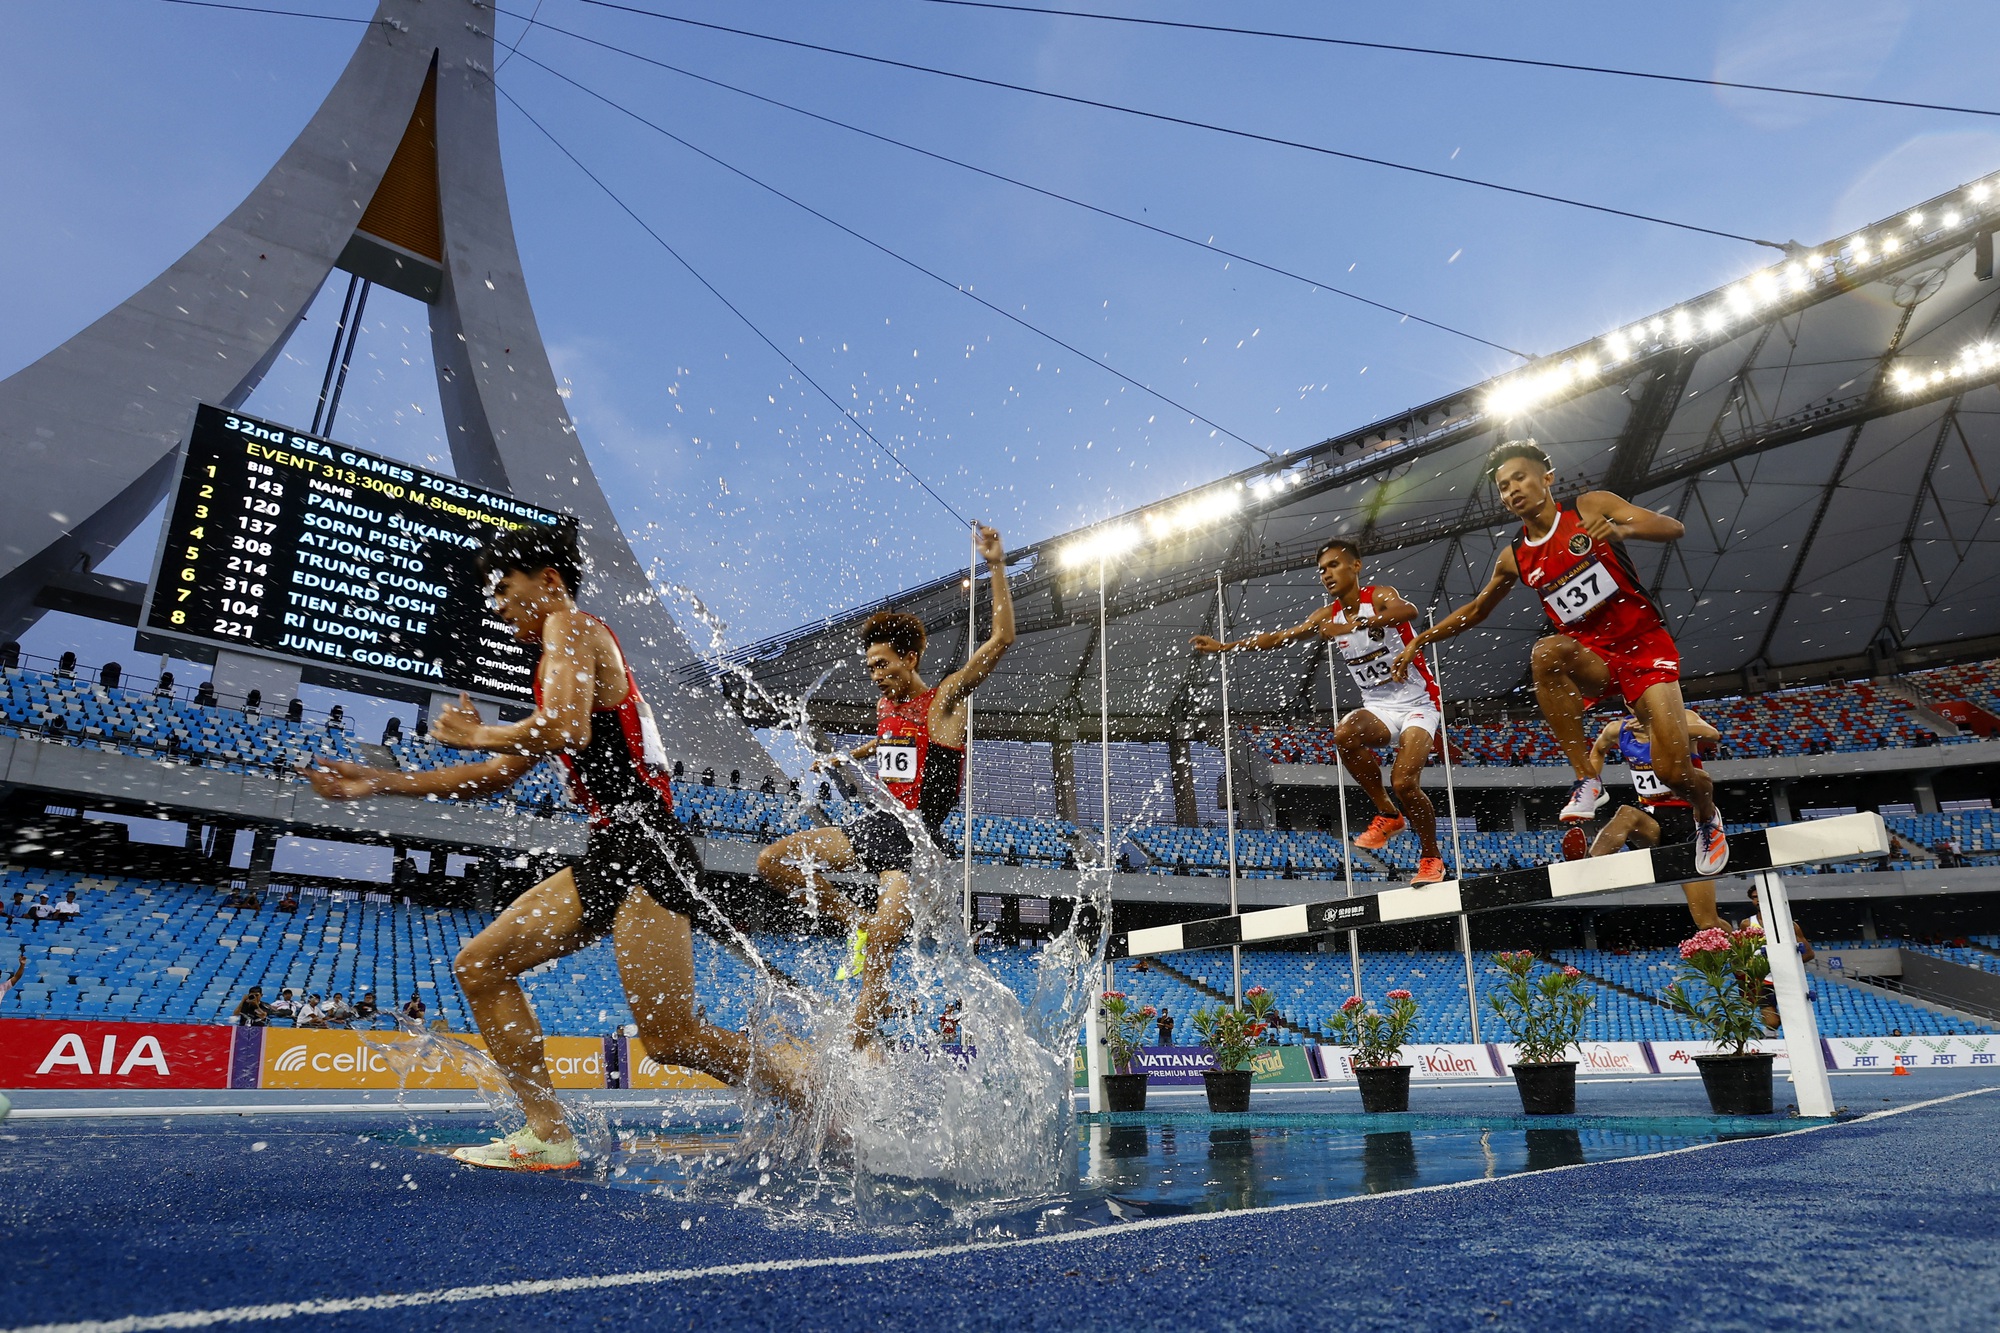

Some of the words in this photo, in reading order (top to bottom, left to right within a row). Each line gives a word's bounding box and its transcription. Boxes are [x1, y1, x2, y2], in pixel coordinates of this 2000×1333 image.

[225, 416, 284, 444] 32nd
[290, 437, 334, 461] SEA
[340, 452, 414, 483] GAMES
[419, 476, 557, 526] 2023-Athletics
[246, 442, 319, 472] EVENT
[322, 465, 405, 498] 313:3000
[247, 461, 274, 476] BIB
[309, 479, 353, 499] NAME
[199, 484, 214, 499] 2
[242, 496, 281, 517] 120
[303, 512, 363, 539] SORN
[369, 529, 423, 555] PISEY
[206, 465, 217, 479] 1
[247, 476, 284, 497] 143
[307, 493, 383, 523] PANDU
[388, 516, 477, 551] SUKARYA
[194, 504, 209, 519] 3
[238, 516, 277, 536] 137
[298, 531, 385, 563] ATJONG
[390, 553, 424, 573] TIO
[185, 546, 199, 560] 5
[226, 556, 268, 577] 214
[292, 570, 380, 602] EDUARD
[384, 593, 436, 616] JOSH
[189, 526, 205, 540] 4
[231, 535, 272, 557] 308
[296, 550, 371, 580] TRUNG
[376, 571, 448, 599] CUONG
[181, 568, 196, 582] 6
[222, 577, 264, 598] 316
[287, 591, 337, 614] TIEN
[343, 604, 400, 629] LONG
[405, 619, 428, 634] LE
[479, 637, 523, 655] Vietnam
[1556, 572, 1600, 614] 137
[177, 588, 192, 602] 7
[220, 598, 259, 618] 104
[283, 612, 305, 628] RI
[312, 618, 378, 644] UDOM
[476, 656, 531, 676] Cambodia
[170, 610, 186, 625] 8
[213, 619, 253, 639] 221
[278, 633, 346, 658] JUNEL
[352, 648, 444, 679] GOBOTIA
[474, 675, 533, 695] Philippines
[1355, 661, 1391, 682] 143
[1636, 775, 1663, 790] 21
[35, 1033, 170, 1076] AIA
[1137, 1054, 1214, 1067] VATTANAC
[1147, 1069, 1187, 1077] PREMIUM
[1340, 1056, 1349, 1074] eau
[1418, 1055, 1427, 1072] eau
[1425, 1054, 1477, 1072] Kulen
[1587, 1051, 1632, 1067] Kulen
[1853, 1056, 1879, 1067] FBT
[1892, 1055, 1917, 1066] BT
[1931, 1054, 1957, 1065] FBT
[1970, 1053, 1996, 1064] FBT
